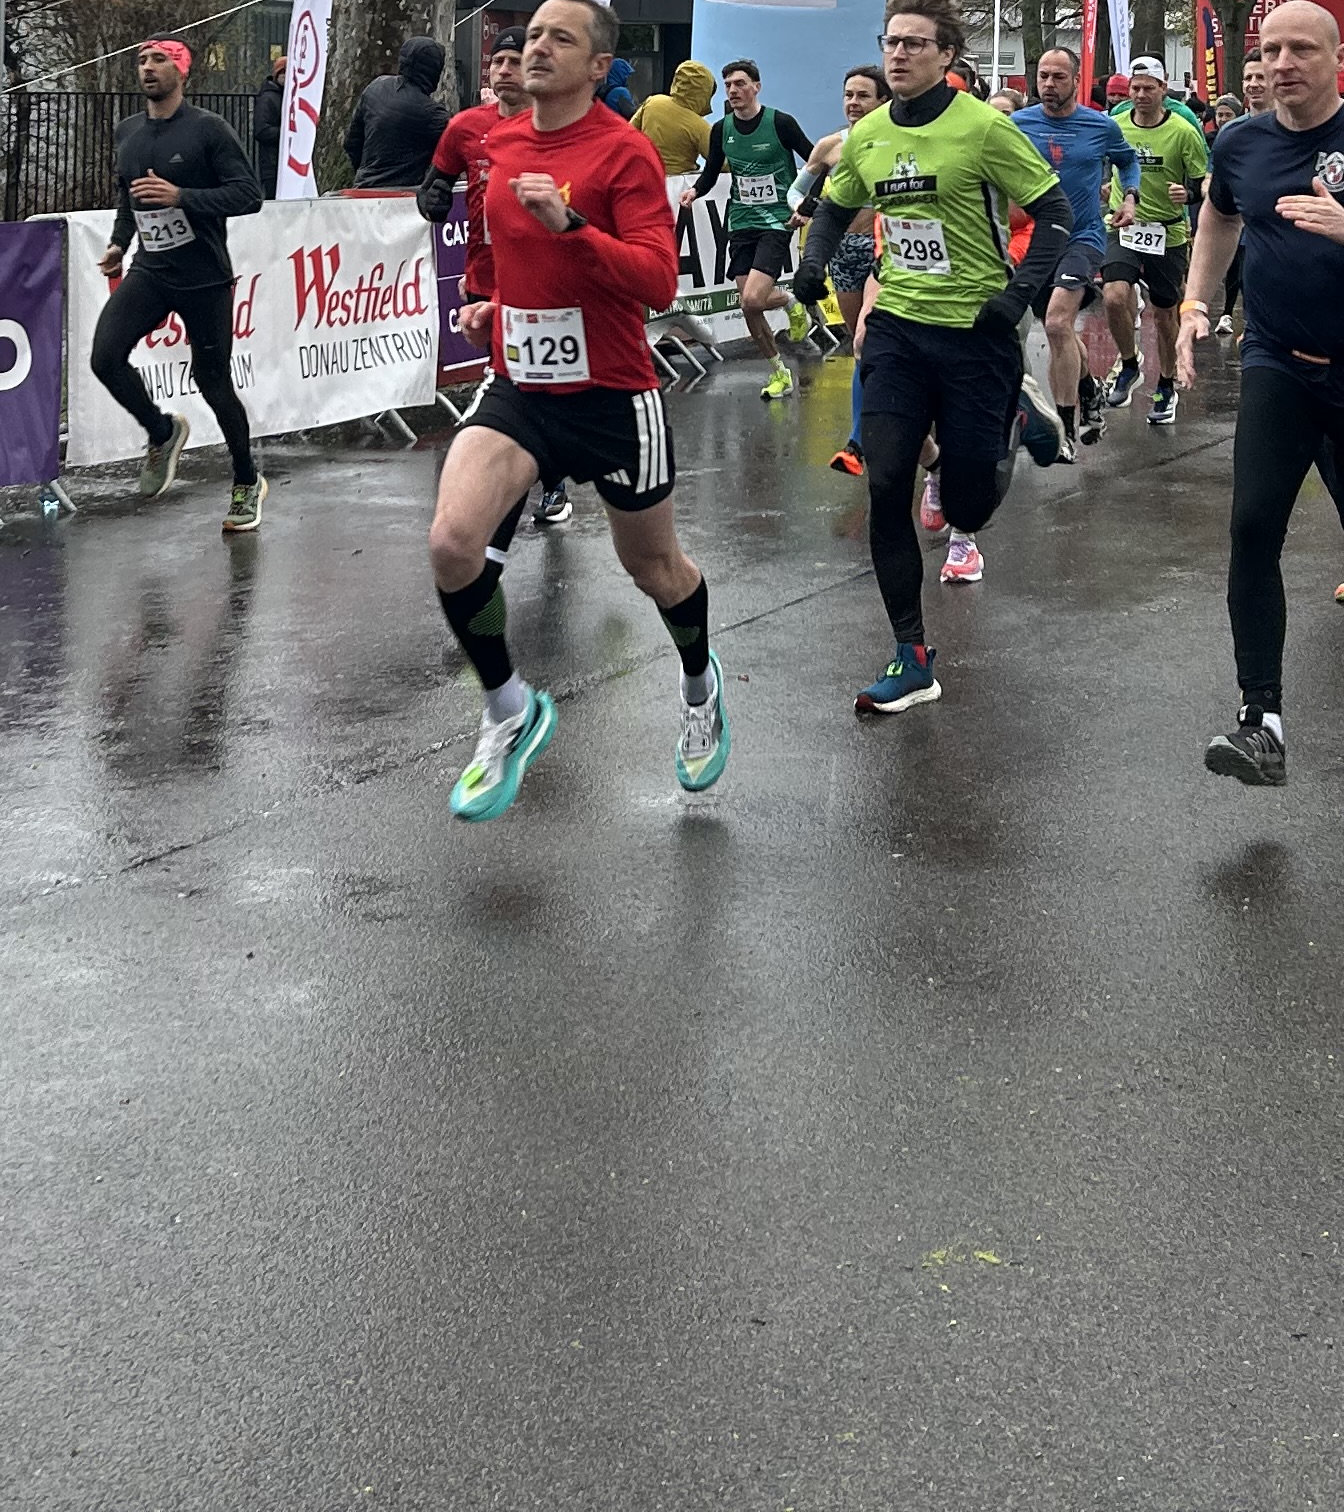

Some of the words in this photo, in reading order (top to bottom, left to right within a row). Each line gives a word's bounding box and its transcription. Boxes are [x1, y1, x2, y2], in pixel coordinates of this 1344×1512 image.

[749, 184, 774, 198] 473
[909, 178, 926, 191] for
[150, 219, 187, 241] 213
[1134, 232, 1164, 247] 287
[900, 238, 944, 261] 298
[287, 243, 428, 332] Westfield
[299, 340, 349, 379] DONAU
[352, 328, 433, 371] ZENTRUM
[522, 335, 580, 366] 129
